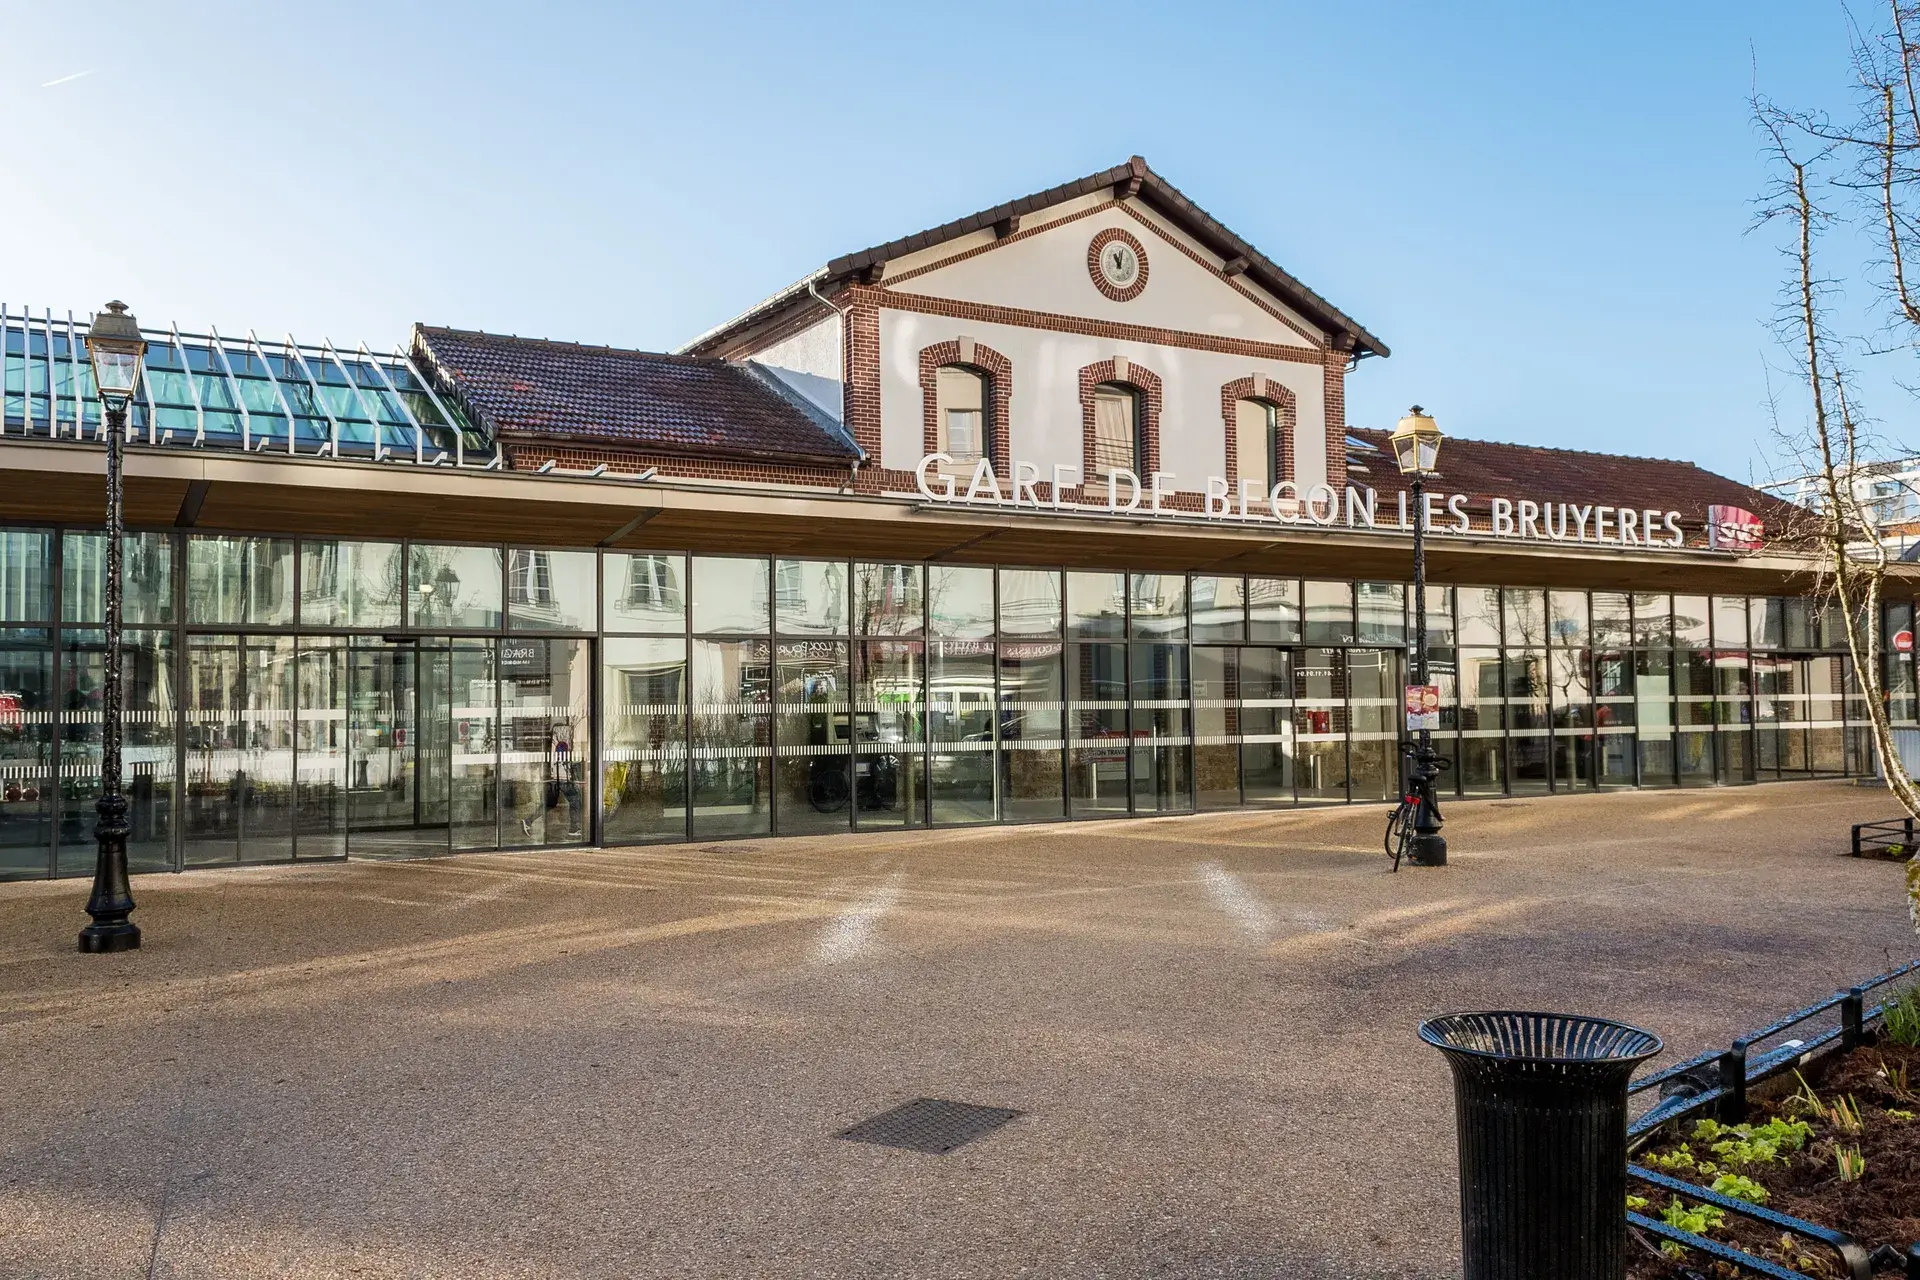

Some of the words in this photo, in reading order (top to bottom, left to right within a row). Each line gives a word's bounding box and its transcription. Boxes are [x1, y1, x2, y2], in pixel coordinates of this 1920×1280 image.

[916, 453, 1077, 510] GARE
[1109, 468, 1176, 516] DE
[1206, 476, 1376, 528] BECON
[1399, 491, 1470, 534] LES
[1492, 498, 1684, 548] BRUYERES
